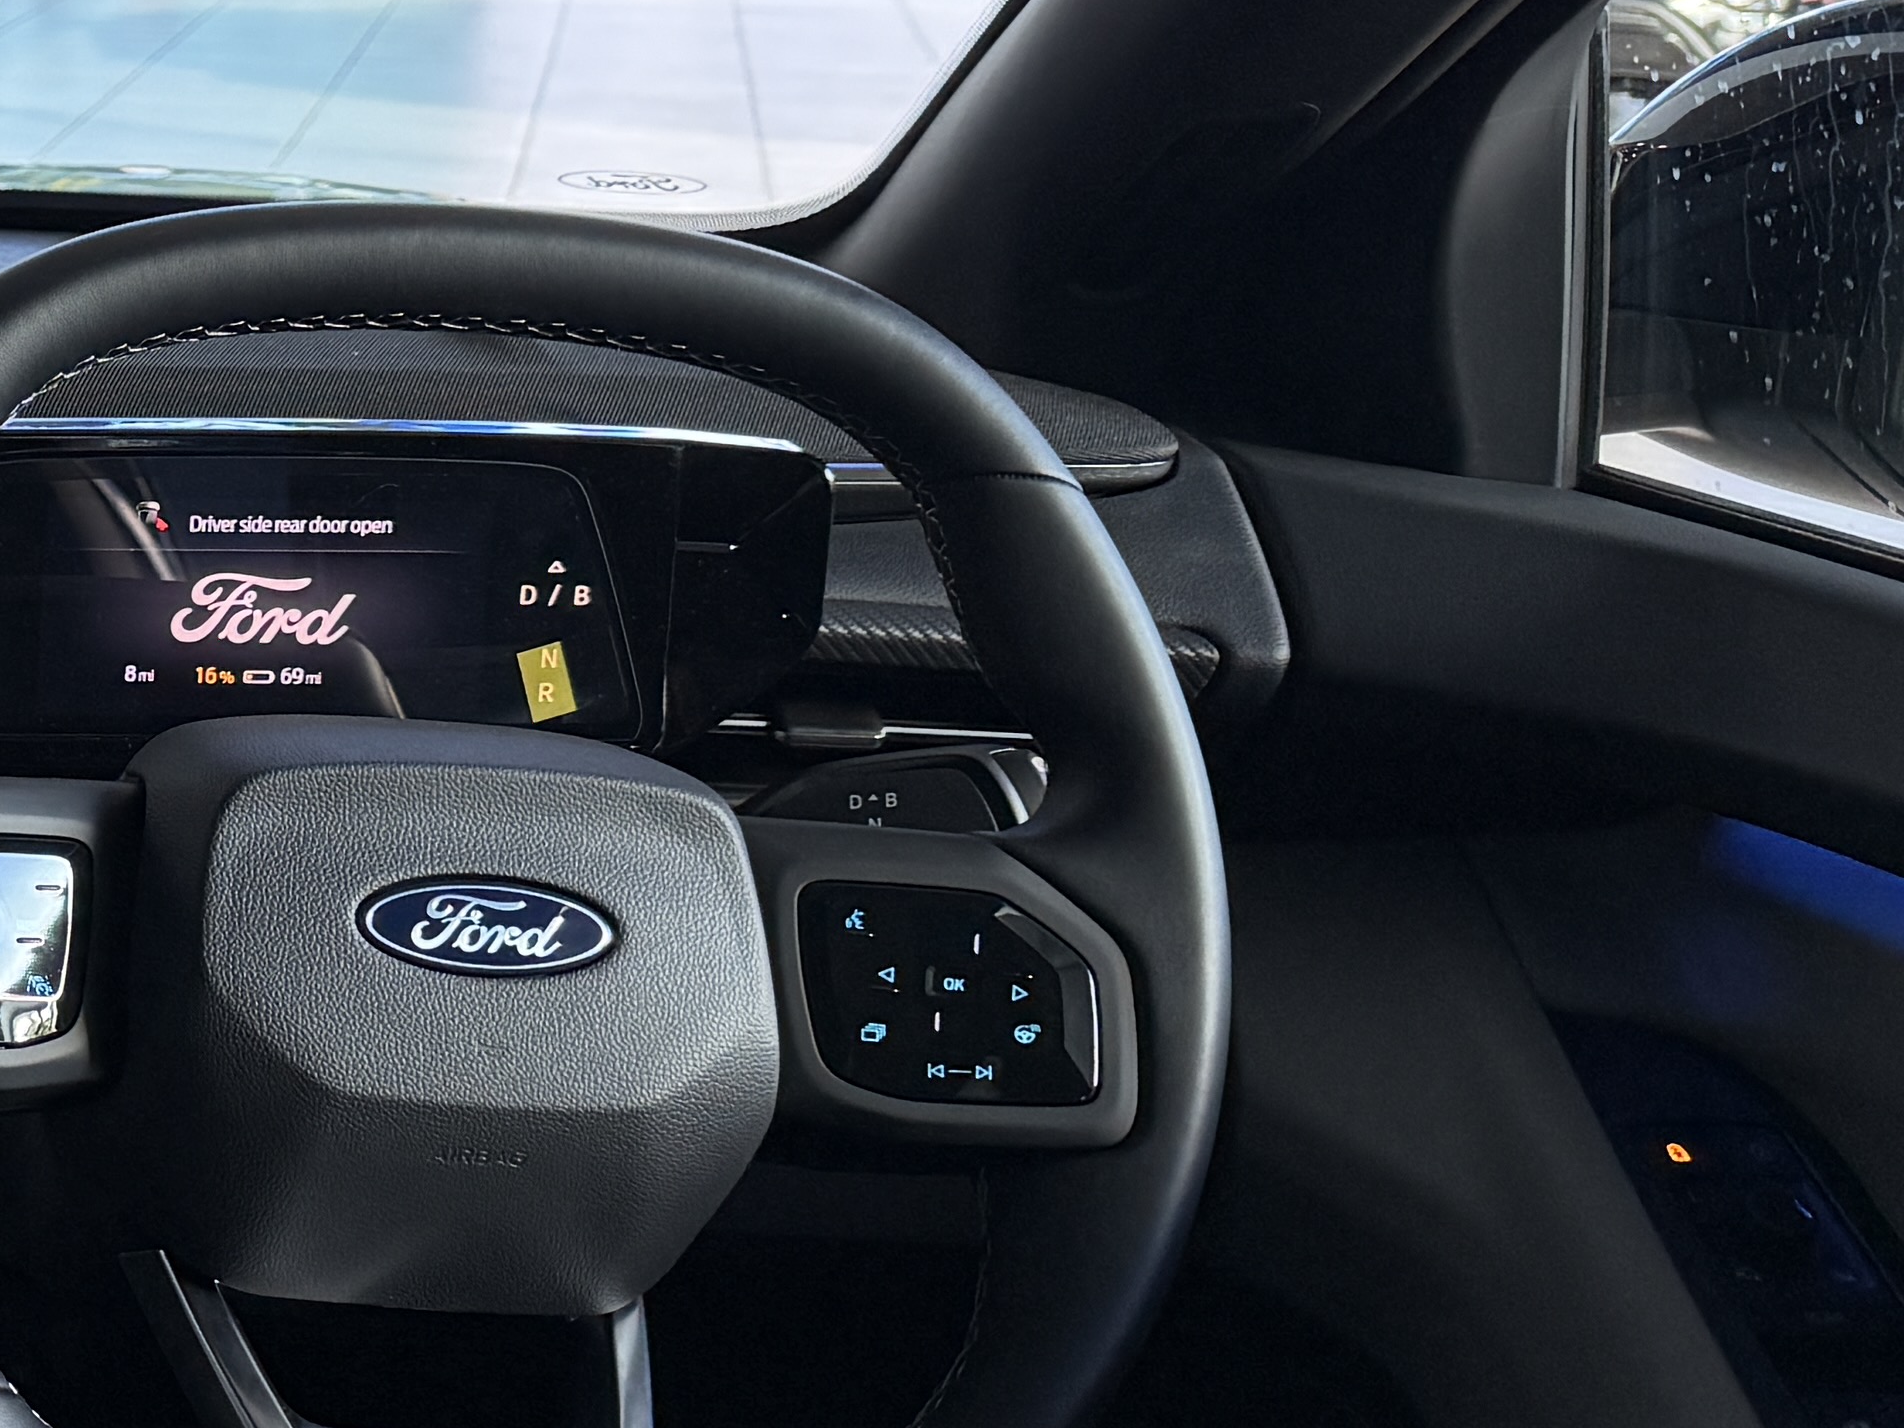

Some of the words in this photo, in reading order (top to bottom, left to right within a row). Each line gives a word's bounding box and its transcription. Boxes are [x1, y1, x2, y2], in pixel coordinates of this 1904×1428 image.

[188, 515, 237, 534] Driver
[238, 515, 273, 534] side
[274, 519, 306, 534] rear
[308, 515, 349, 534] door
[349, 519, 394, 537] open
[519, 584, 539, 606] D
[573, 584, 592, 606] B
[170, 572, 357, 646] Ford
[541, 648, 559, 669] N
[538, 682, 555, 703] R
[849, 794, 863, 810] D
[885, 792, 898, 808] B
[410, 894, 569, 958] Ford
[943, 978, 965, 992] OK
